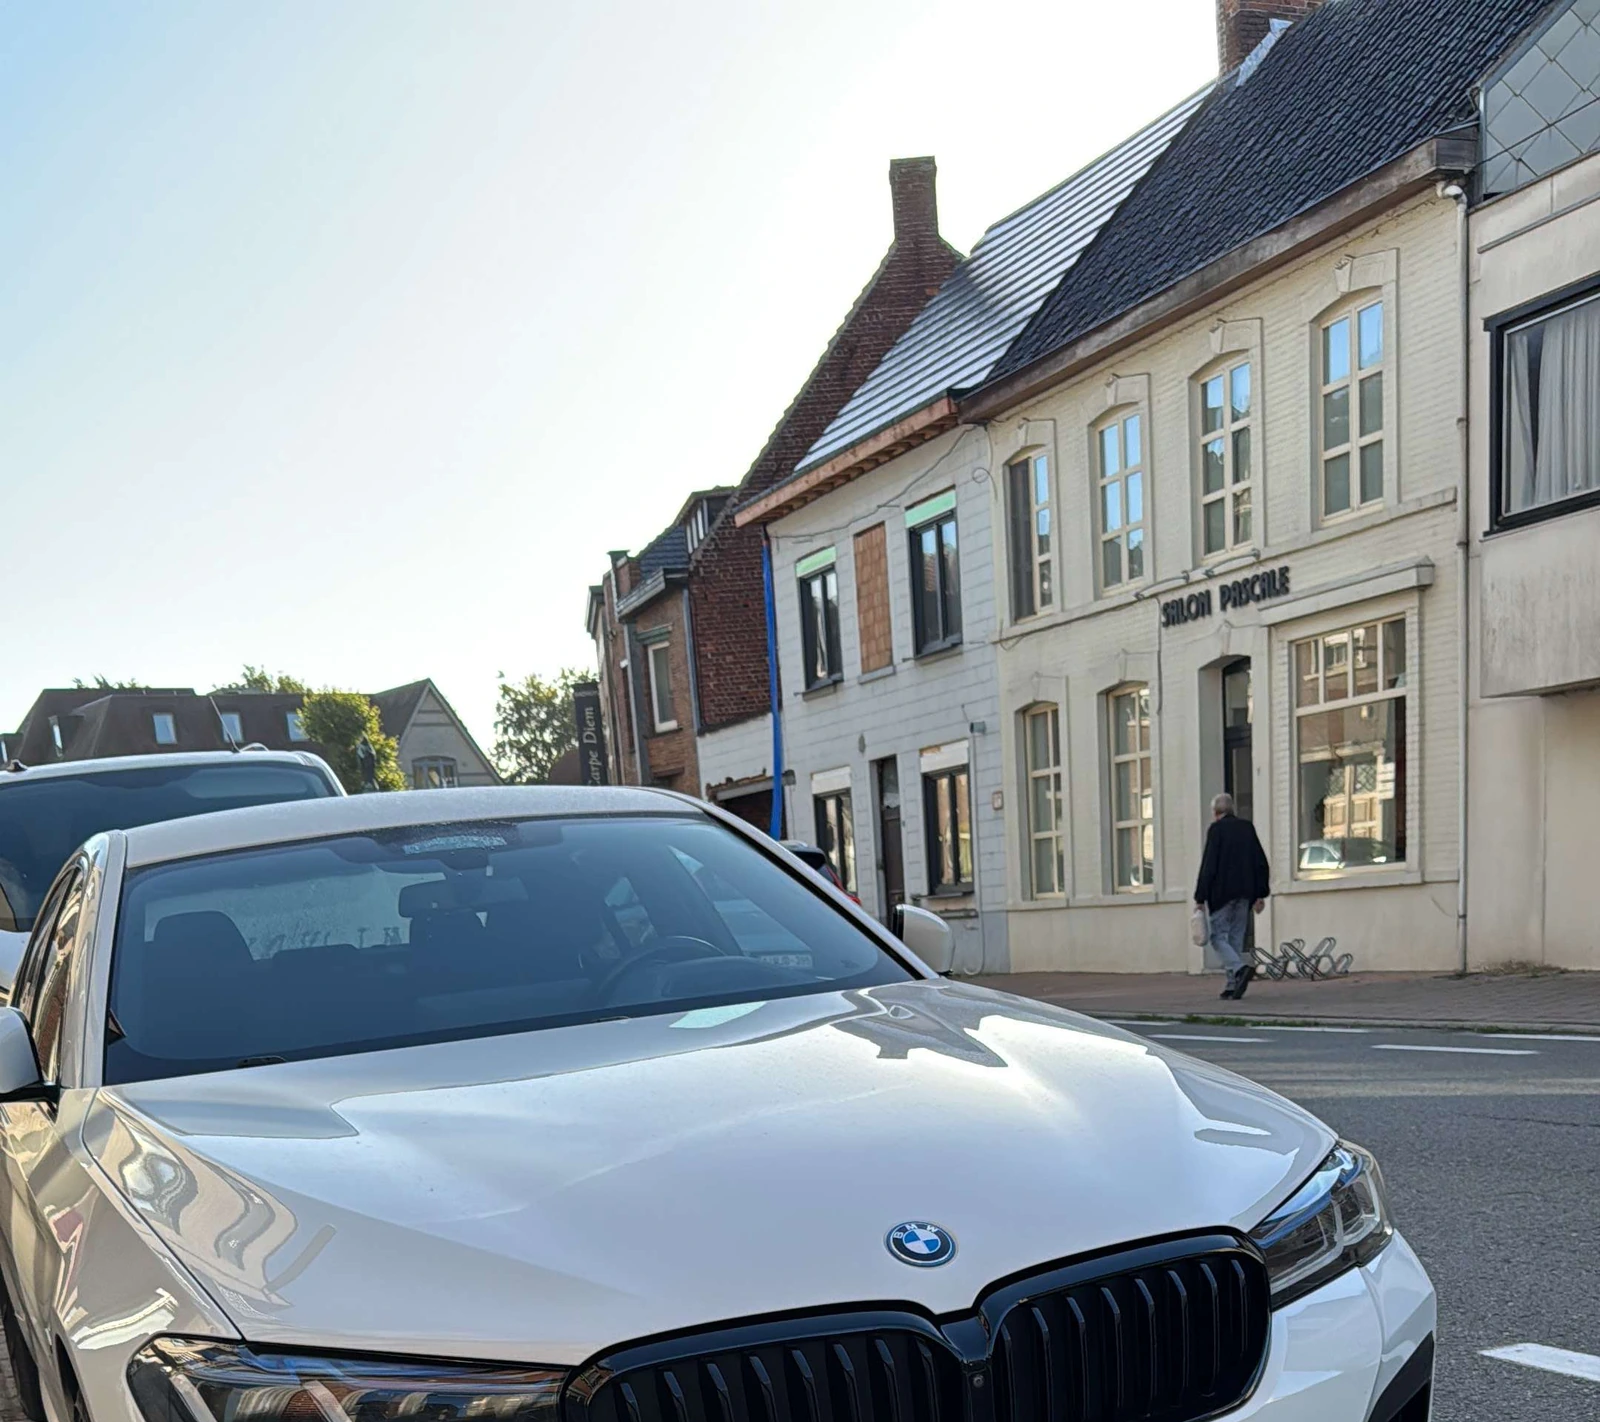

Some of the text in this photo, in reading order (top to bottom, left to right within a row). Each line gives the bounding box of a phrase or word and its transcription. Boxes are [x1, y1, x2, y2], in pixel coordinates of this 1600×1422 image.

[1162, 566, 1290, 628] SALON PASCALE
[583, 706, 597, 744] Diem
[893, 1223, 939, 1239] BMW
